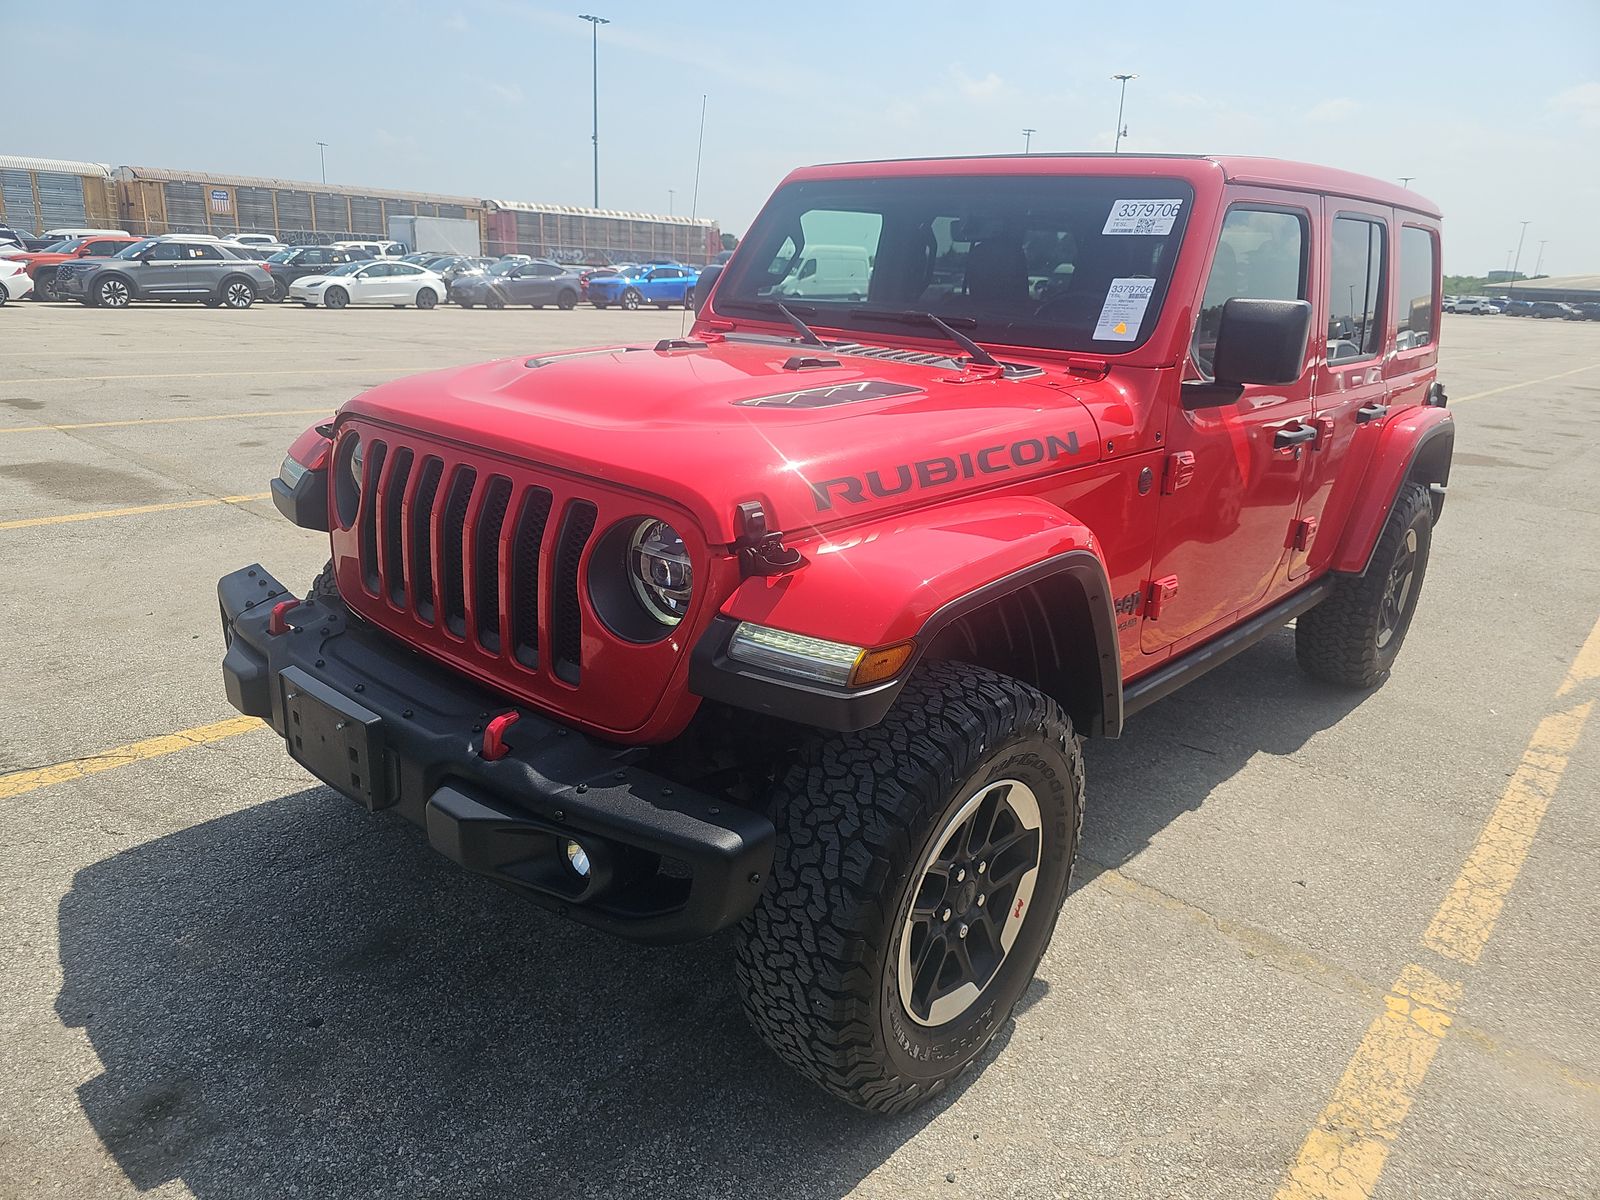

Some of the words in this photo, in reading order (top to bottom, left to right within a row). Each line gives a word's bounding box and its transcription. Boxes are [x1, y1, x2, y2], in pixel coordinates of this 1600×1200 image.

[1118, 203, 1181, 217] 3379706
[1111, 285, 1153, 294] 3379706
[813, 431, 1080, 512] RUBICON
